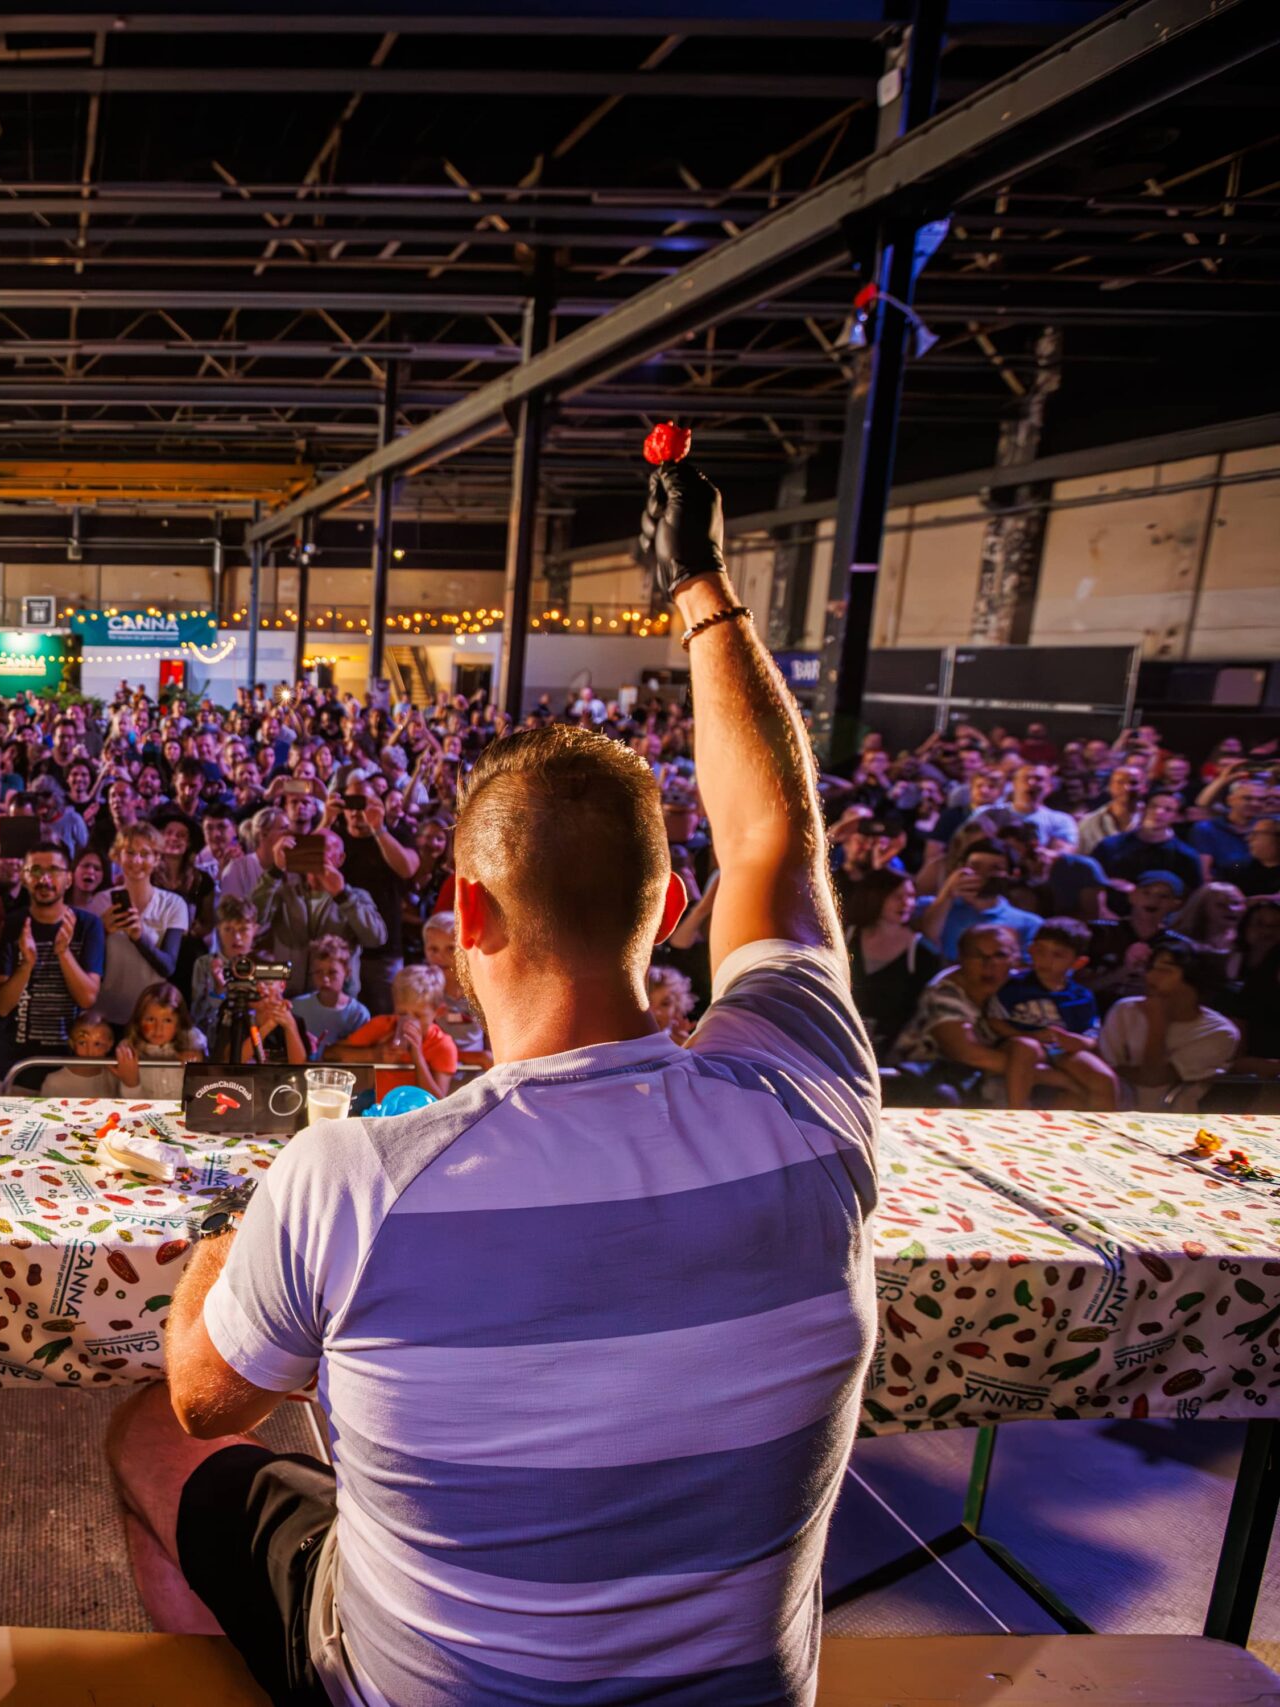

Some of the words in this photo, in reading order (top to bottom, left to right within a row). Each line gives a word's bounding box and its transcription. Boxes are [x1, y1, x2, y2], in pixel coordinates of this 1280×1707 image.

[107, 615, 179, 631] CANNA
[10, 1121, 37, 1150] CANNA
[10, 1183, 37, 1214] CANNA
[63, 1170, 88, 1200] CANNA
[114, 1214, 184, 1229] ANNA
[62, 1240, 96, 1319] CANNA
[1098, 1241, 1128, 1326] CNNA
[87, 1340, 160, 1356] CANNA
[963, 1383, 1044, 1412] CANNA
